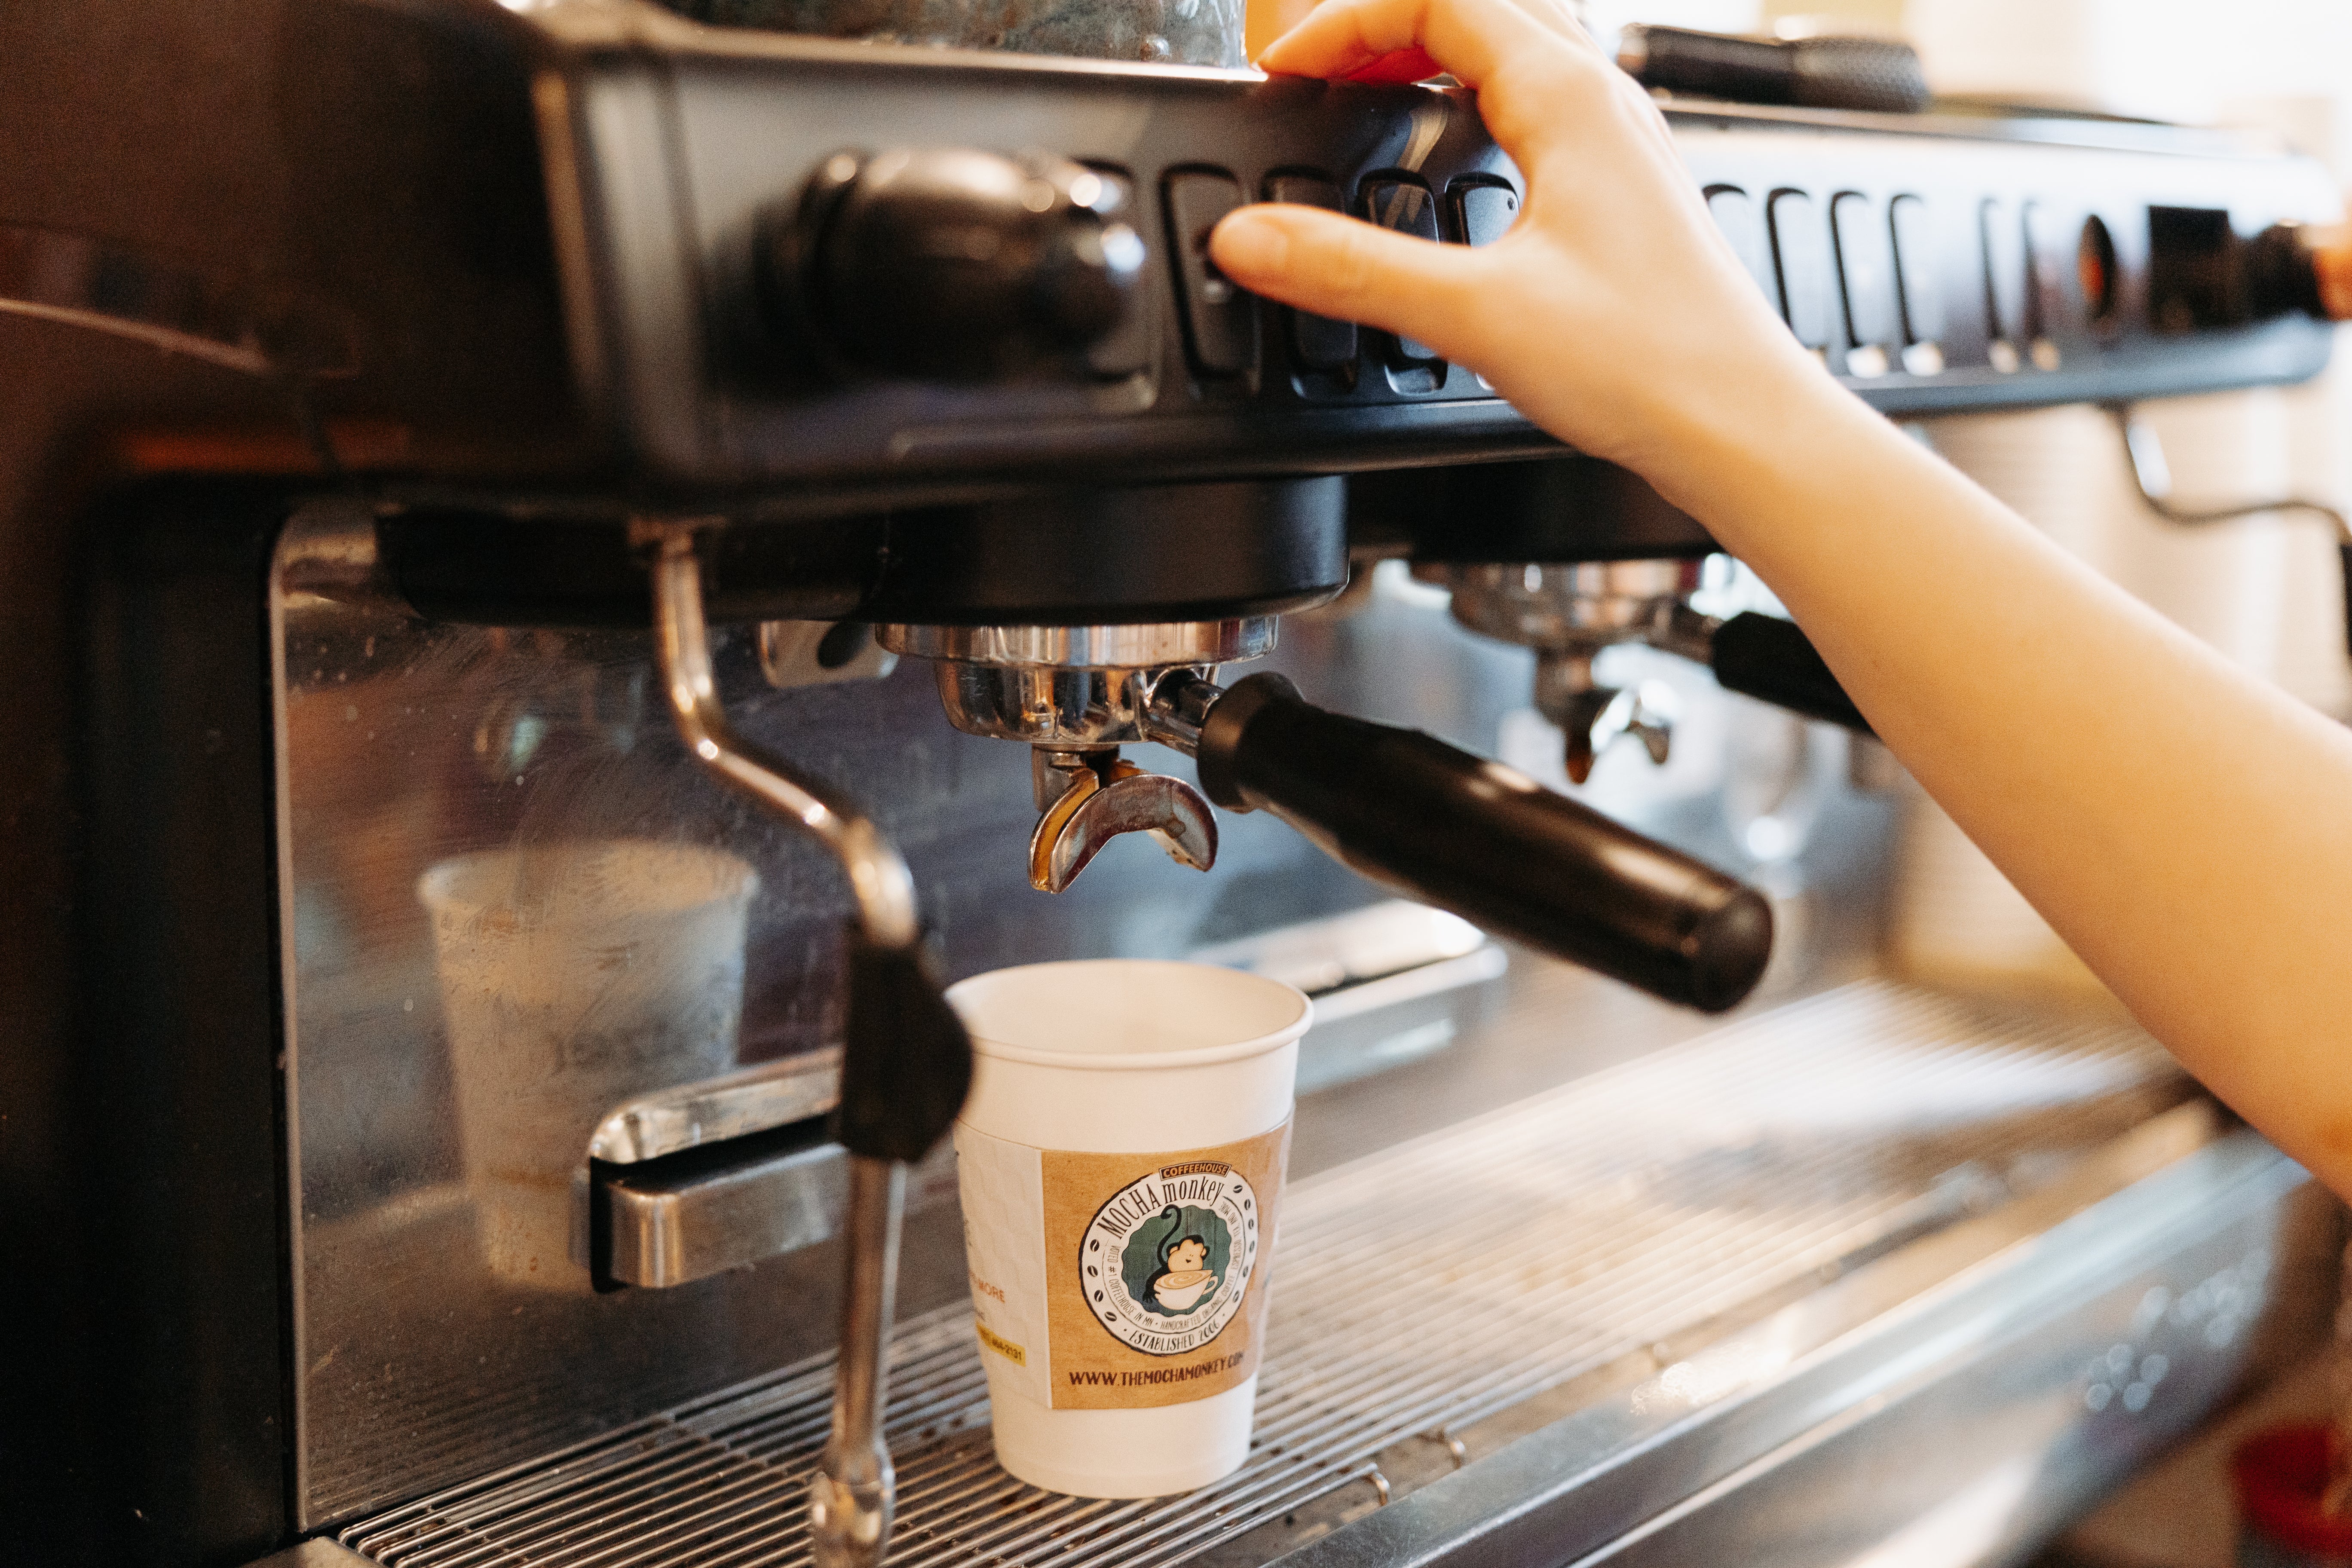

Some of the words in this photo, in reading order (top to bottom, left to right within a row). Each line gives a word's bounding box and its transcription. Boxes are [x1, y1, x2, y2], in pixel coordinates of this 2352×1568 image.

[1163, 1162, 1228, 1178] COFFEEHOUSE
[1096, 1184, 1161, 1239] MOCHA
[1161, 1176, 1225, 1207] monkey
[1227, 1212, 1238, 1225] AND
[1107, 1246, 1121, 1263] VOTED
[1108, 1265, 1116, 1277] #1
[1109, 1278, 1137, 1316] COFFEEHOUSE
[1133, 1312, 1143, 1322] IN
[1142, 1316, 1154, 1327] MN
[1160, 1314, 1201, 1330] HANDCRAFTED
[1129, 1330, 1194, 1351] ESTABLISHED
[1198, 1318, 1220, 1341] 2006
